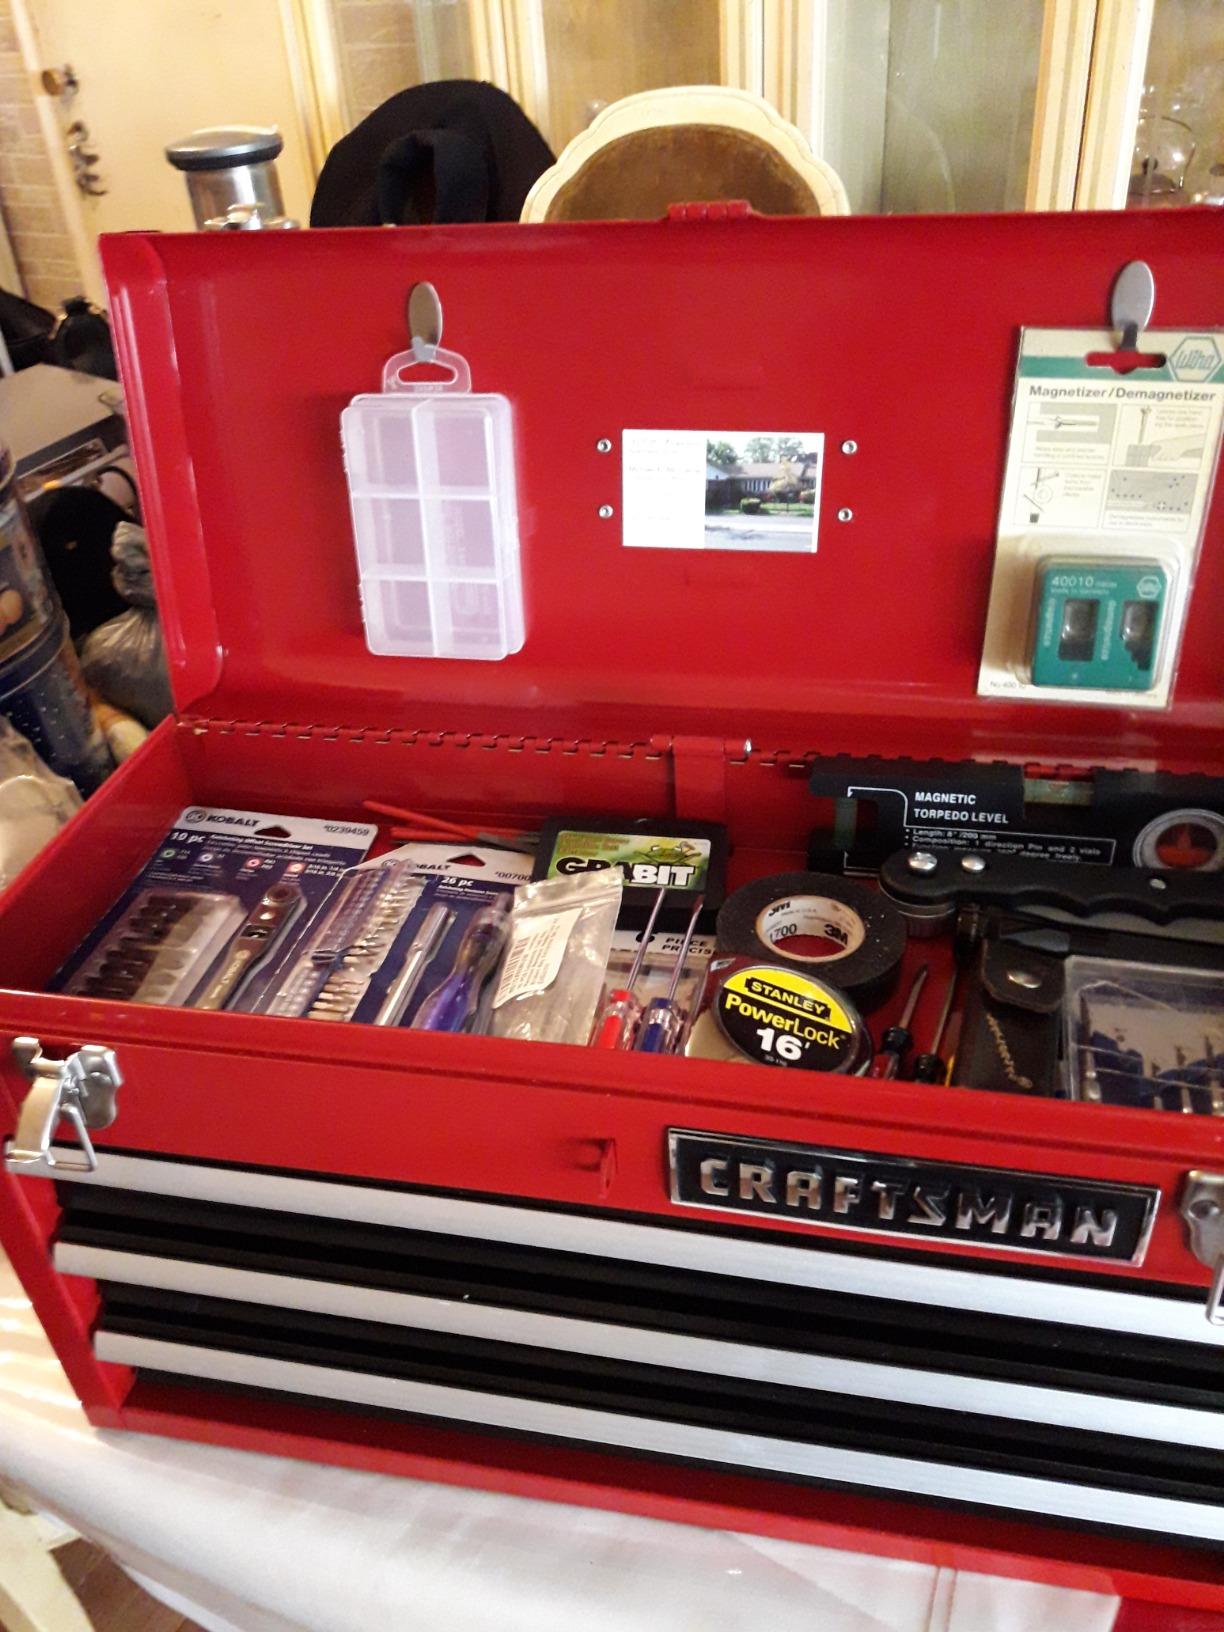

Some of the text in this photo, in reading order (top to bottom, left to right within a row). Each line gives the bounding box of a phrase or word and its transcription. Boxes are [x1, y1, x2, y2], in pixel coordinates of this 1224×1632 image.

[1051, 576, 1094, 587] 40010
[914, 792, 976, 805] MAGNETIC
[206, 815, 260, 828] KOBALT
[913, 808, 1009, 824] TORPEDO LEVEL
[170, 831, 206, 844] 10 pc
[912, 836, 970, 846] Composition:
[1048, 844, 1065, 853] and
[458, 879, 474, 887] pc
[768, 900, 791, 917] 3M
[823, 923, 849, 946] 3M
[751, 981, 826, 1015] STANLEY
[725, 993, 840, 1050] PowerLock
[756, 1027, 811, 1061] 16'
[700, 1155, 1117, 1248] CRAFTSMAN
